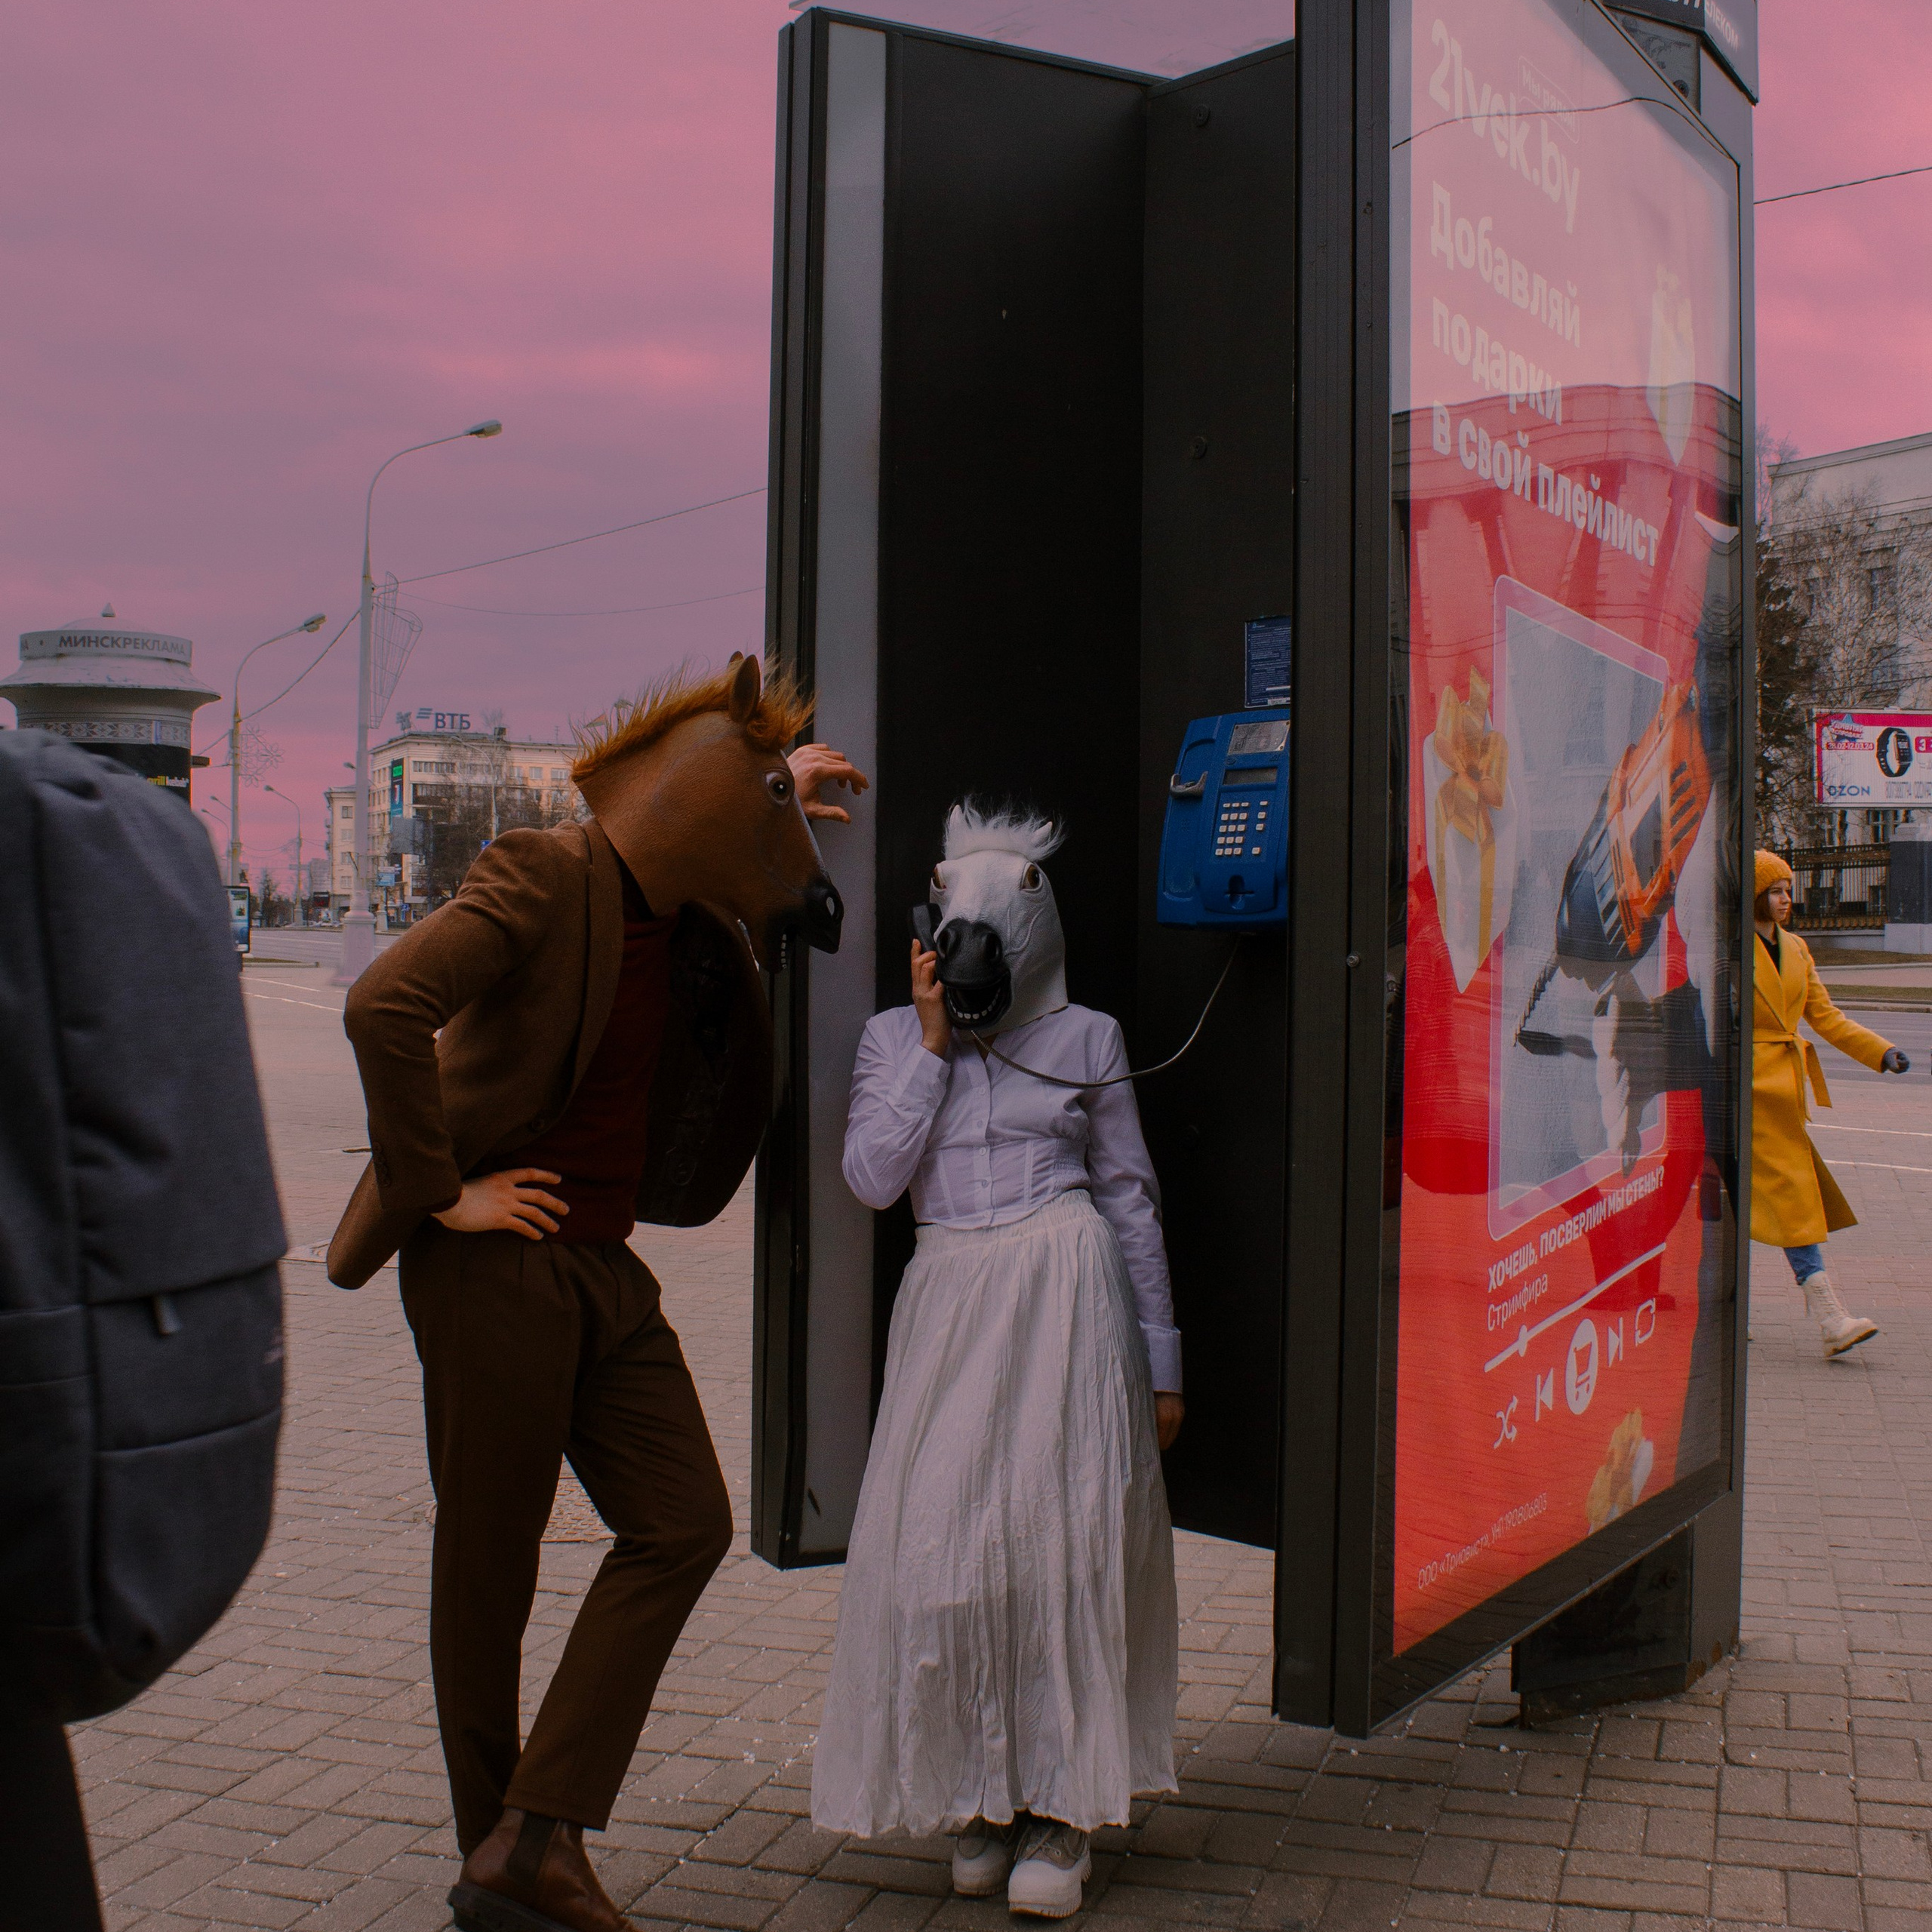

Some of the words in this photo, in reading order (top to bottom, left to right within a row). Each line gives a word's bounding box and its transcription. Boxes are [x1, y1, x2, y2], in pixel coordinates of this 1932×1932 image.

[1522, 65, 1540, 99] Мы
[1428, 18, 1581, 234] 21vek.by
[1431, 180, 1581, 349] Добавляй
[1432, 297, 1562, 427] подарки
[1432, 399, 1451, 456] в
[1457, 417, 1532, 503] свой
[1538, 462, 1660, 568] плейлист
[59, 635, 186, 655] МИНСКРЕКЛАМА
[435, 712, 471, 730] ВТБ
[1829, 785, 1870, 796] OZON
[1487, 1241, 1537, 1293] ХОЧЕШЬ,
[1540, 1197, 1607, 1258] ПОСВЕРЛИМ
[1607, 1186, 1625, 1217] МЫ
[1626, 1165, 1665, 1205] СТЕНЫ?
[1487, 1273, 1548, 1332] Стримфира
[1417, 1560, 1438, 1590] ООО
[1491, 1517, 1504, 1545] УНП
